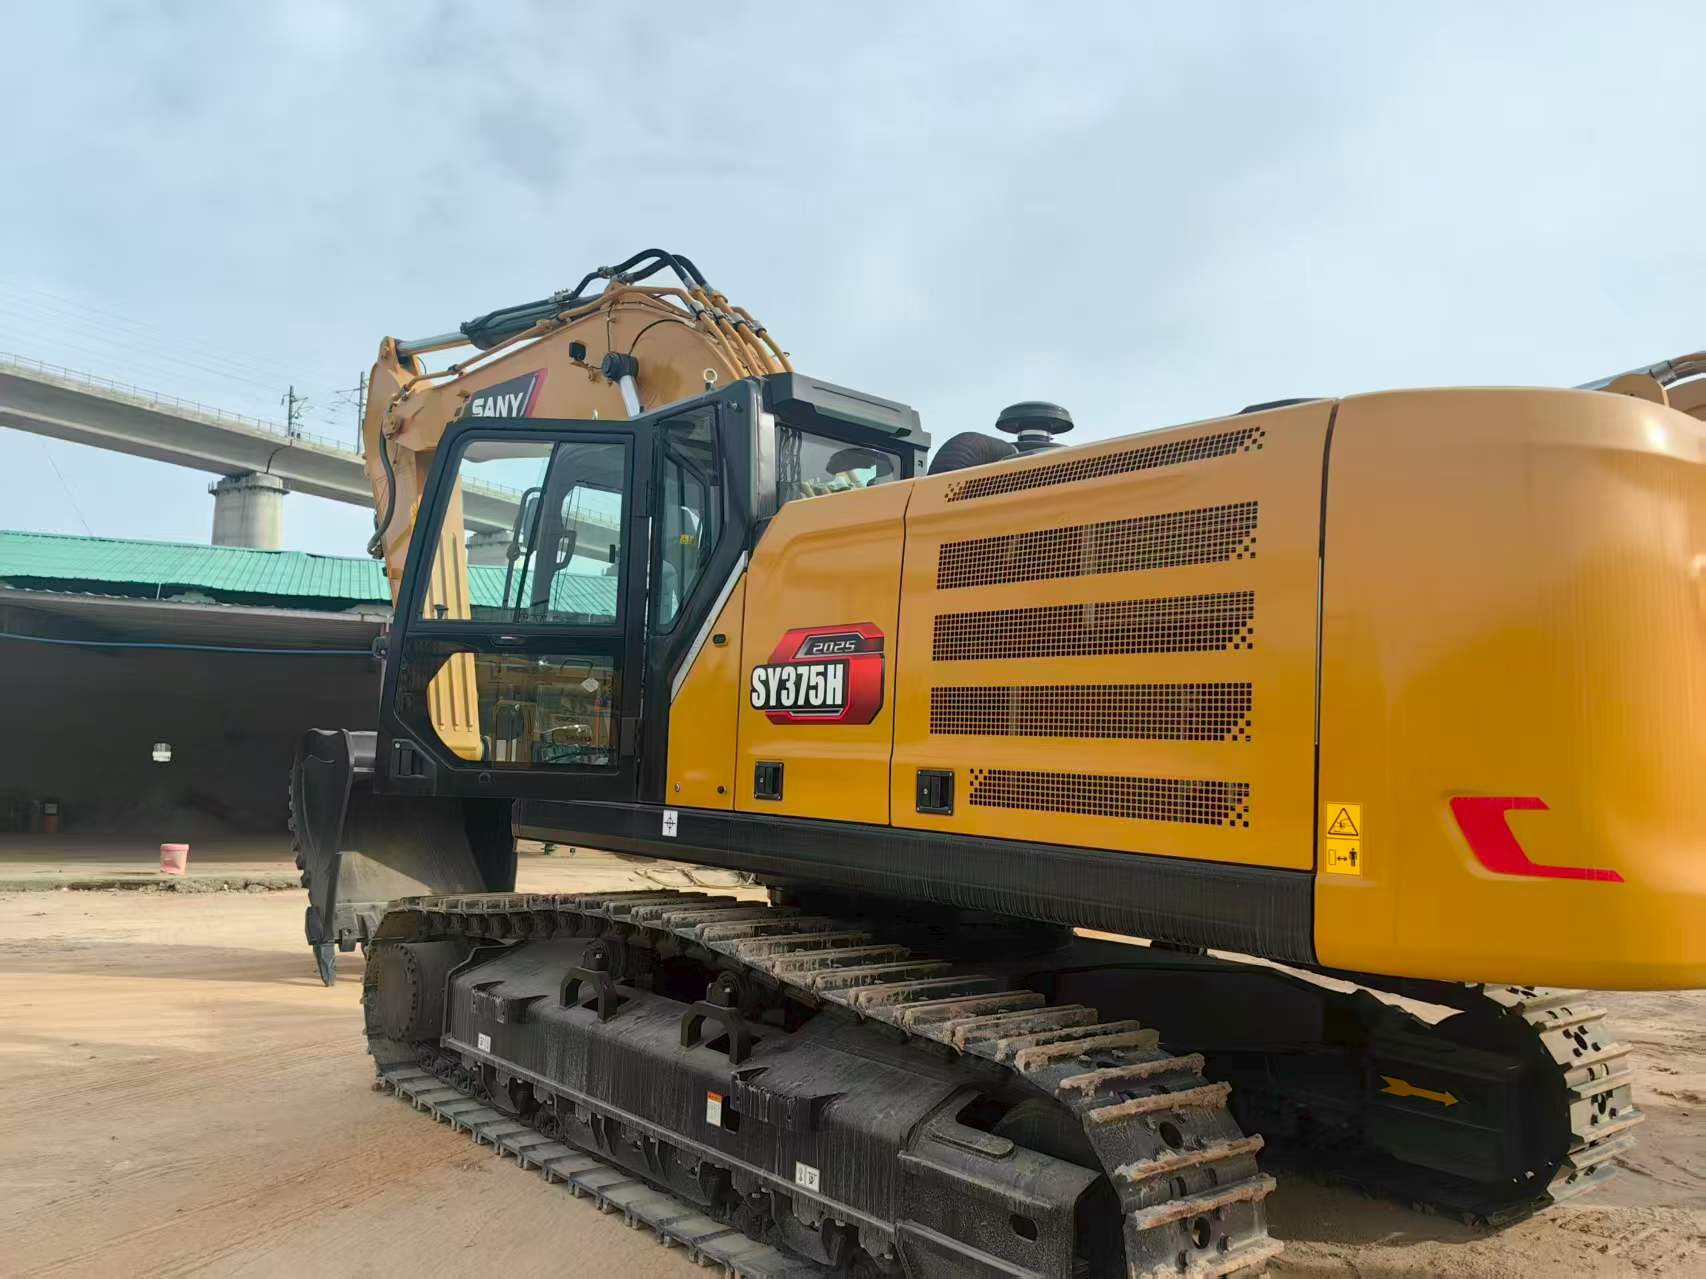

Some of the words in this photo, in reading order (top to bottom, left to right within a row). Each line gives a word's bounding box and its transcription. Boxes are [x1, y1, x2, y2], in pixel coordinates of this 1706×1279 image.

[472, 392, 524, 417] SANY
[812, 640, 856, 653] 2025
[751, 664, 844, 707] SY375H
